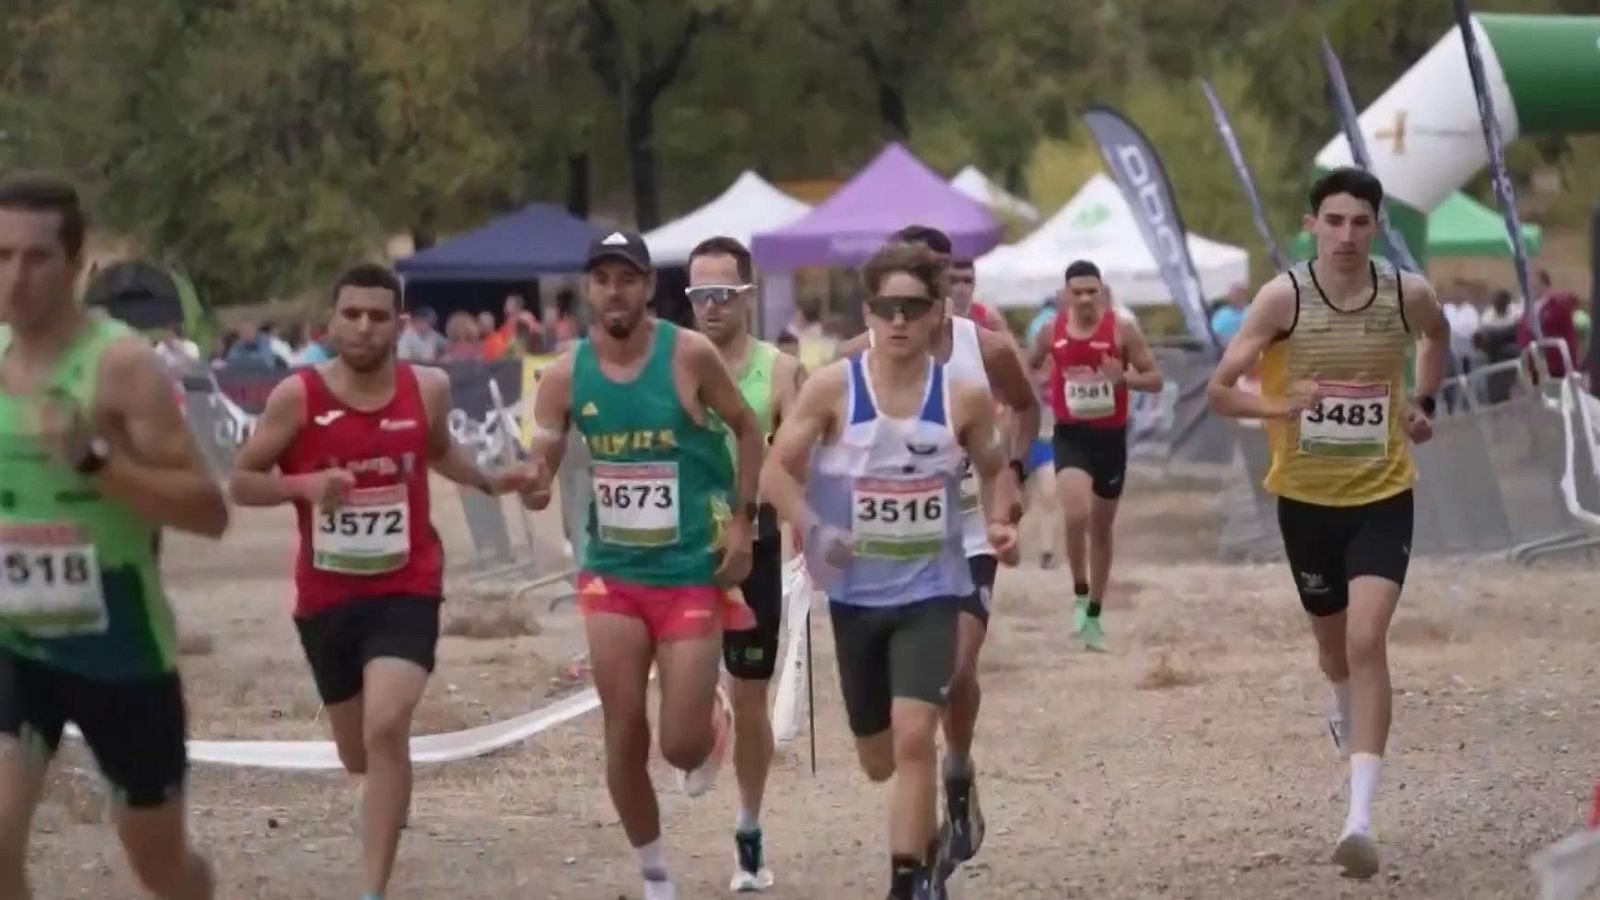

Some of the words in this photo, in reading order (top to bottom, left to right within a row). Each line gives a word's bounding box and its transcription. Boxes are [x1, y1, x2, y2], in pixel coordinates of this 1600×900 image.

[597, 484, 673, 510] 3673
[857, 495, 942, 523] 3516
[320, 508, 404, 536] 3572
[0, 553, 88, 586] 518
